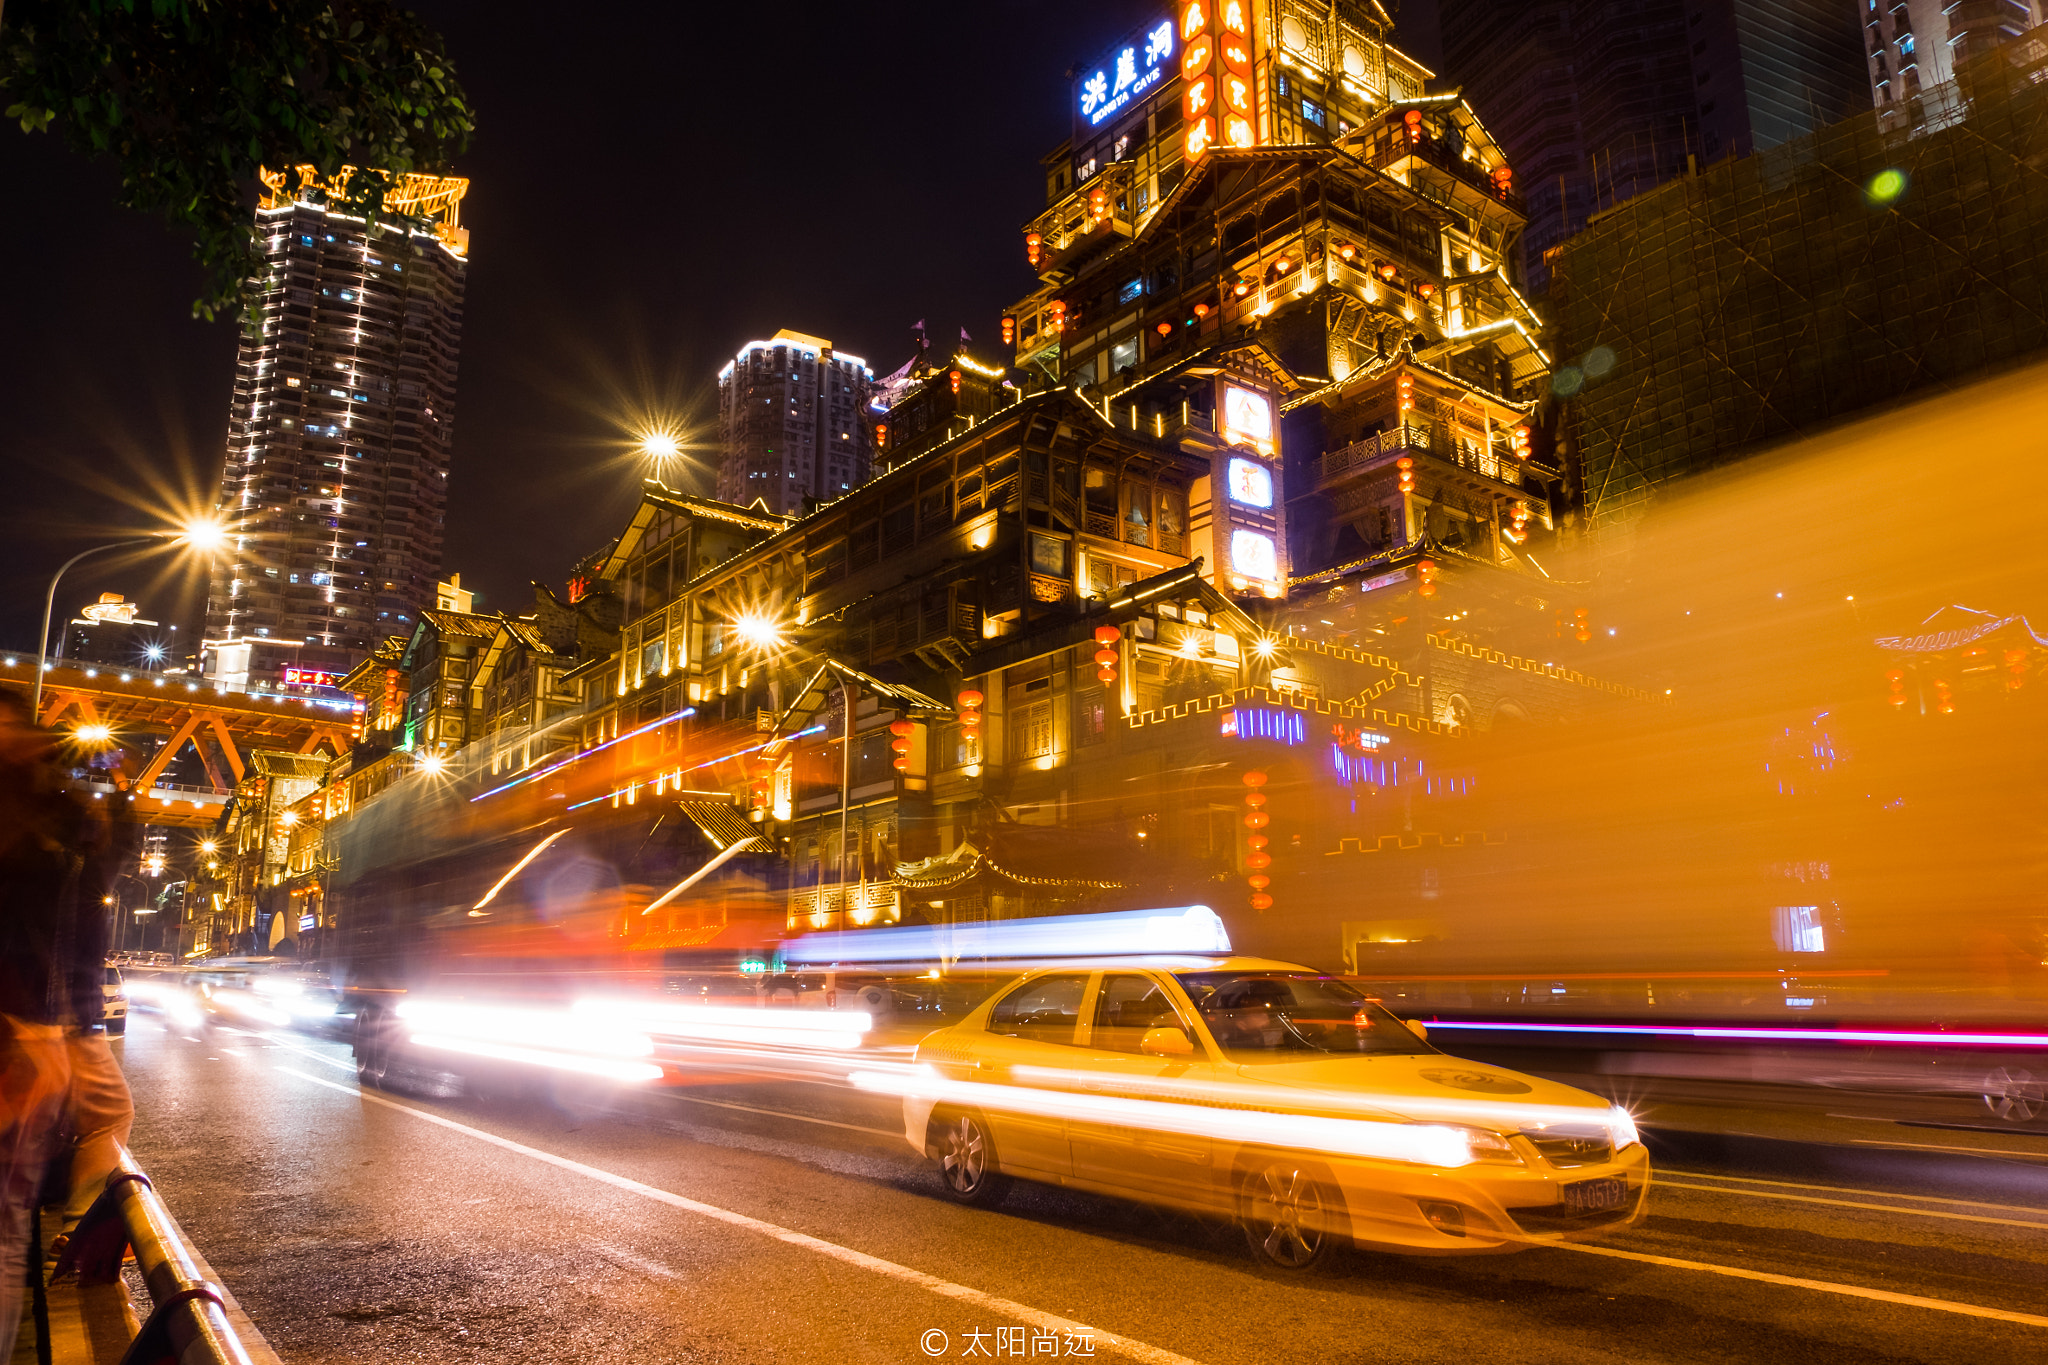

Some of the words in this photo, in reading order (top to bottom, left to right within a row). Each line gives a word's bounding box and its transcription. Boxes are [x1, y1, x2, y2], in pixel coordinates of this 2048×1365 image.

[1081, 21, 1172, 115] 洪崖洞
[1092, 91, 1129, 125] HONGYA
[1133, 67, 1160, 93] CAVE
